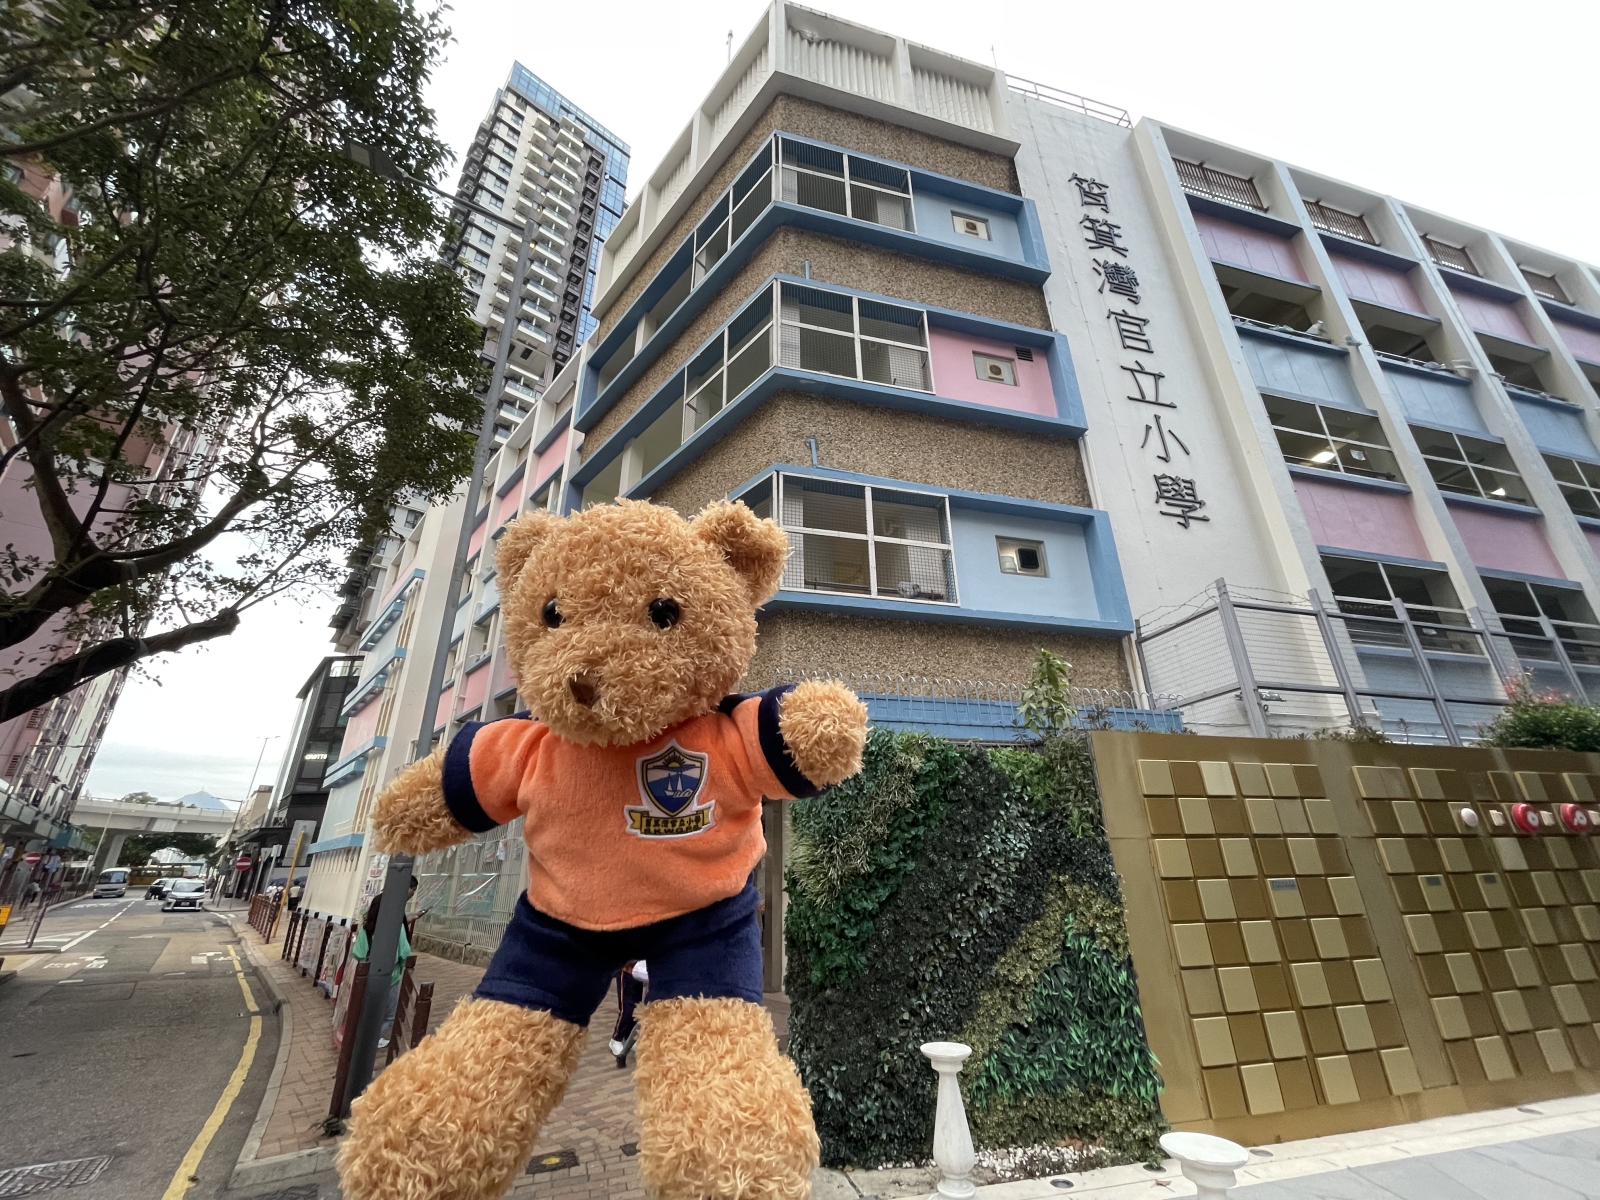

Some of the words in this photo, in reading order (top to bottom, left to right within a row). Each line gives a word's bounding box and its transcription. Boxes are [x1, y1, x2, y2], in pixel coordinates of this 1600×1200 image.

[1068, 172, 1210, 529] 筲箕灣官立小學
